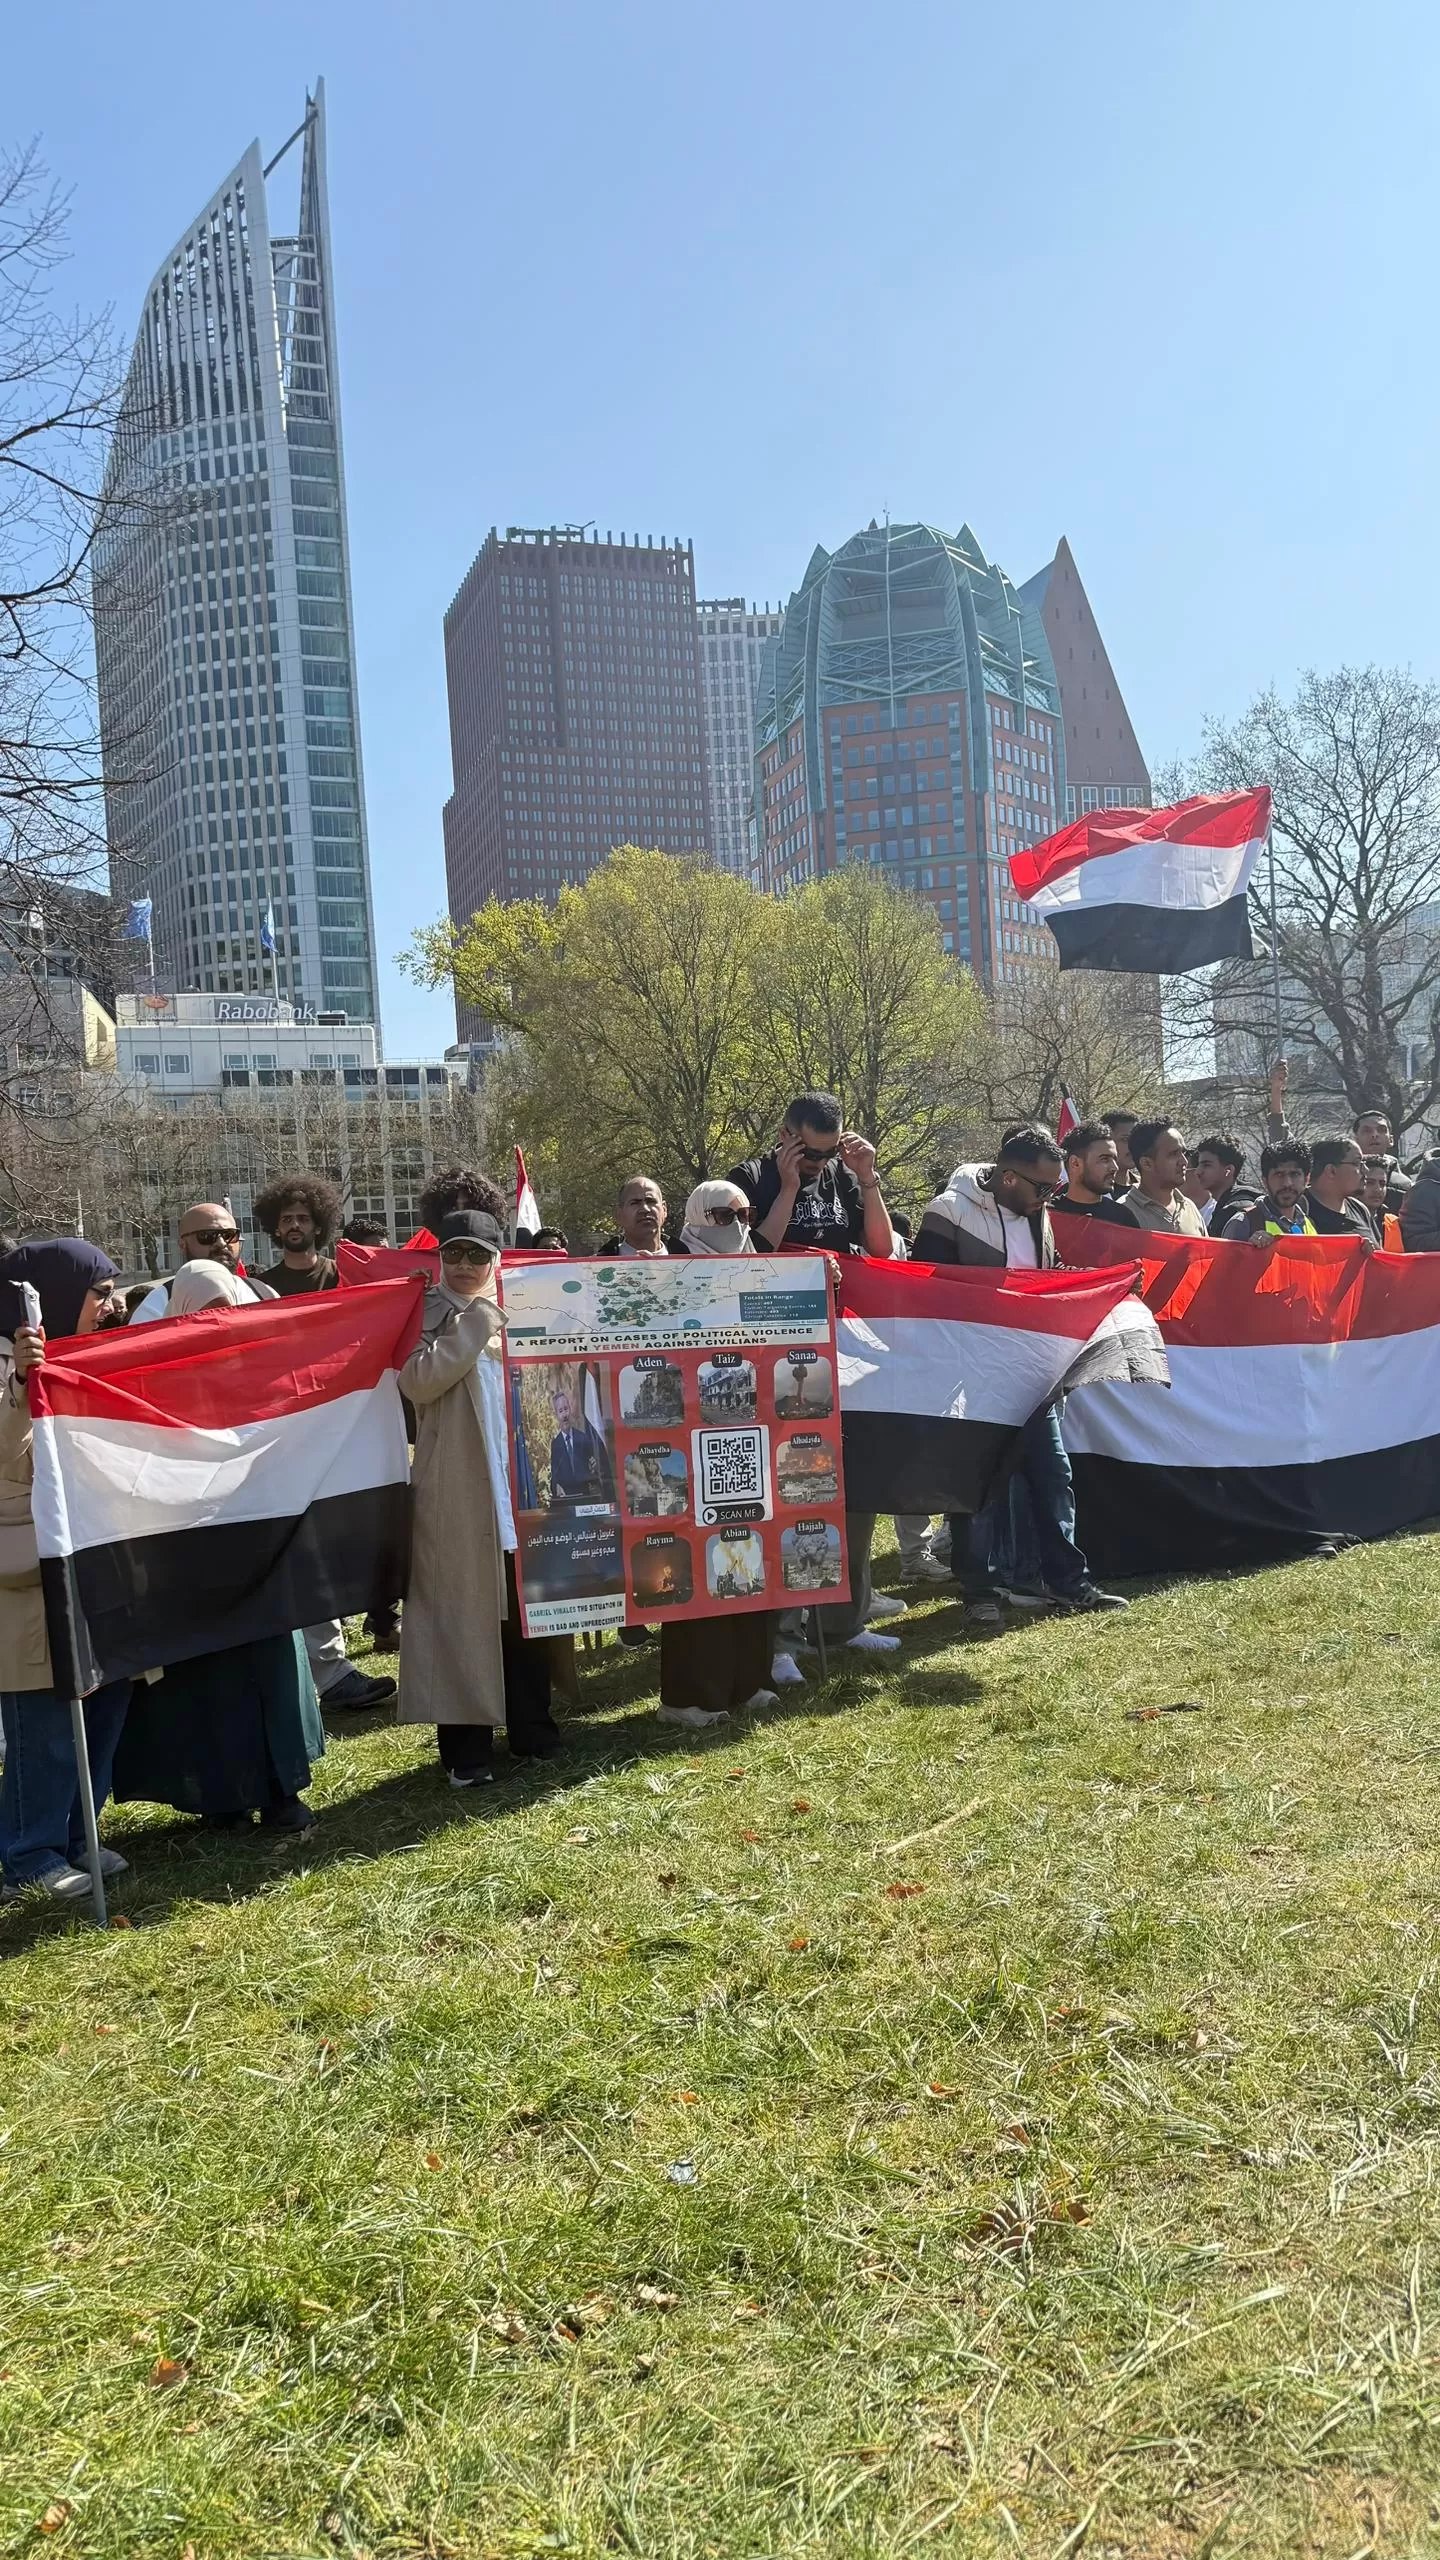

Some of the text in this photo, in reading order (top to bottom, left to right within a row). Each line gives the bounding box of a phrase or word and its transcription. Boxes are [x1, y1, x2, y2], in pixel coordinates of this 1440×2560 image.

[218, 1002, 315, 1021] Rabobank
[515, 1327, 813, 1347] A REPORT ON CASES OF POLITICAL VIOLENCE
[593, 1343, 640, 1351] YEMEN
[645, 1340, 701, 1348] AGAINST
[705, 1337, 768, 1345] CIVILIANS
[715, 1353, 736, 1364] Taiz
[788, 1350, 817, 1361] Sanaa
[636, 1357, 663, 1368] Aden
[720, 1508, 756, 1520] SCAN ME
[724, 1528, 748, 1538] Abian
[798, 1521, 824, 1533] Hajjah
[527, 1535, 543, 1547] اليمن
[543, 1536, 554, 1546] في
[555, 1532, 572, 1545] الوضع
[646, 1535, 674, 1547] Rayma
[571, 1548, 590, 1560] مسبوق
[528, 1608, 552, 1618] GABRIEL
[577, 1604, 588, 1612] THE
[589, 1602, 616, 1611] SITUATION
[530, 1625, 548, 1634] YEMEN
[549, 1623, 555, 1631] IS
[556, 1622, 567, 1631] BAD
[568, 1621, 580, 1629] AND
